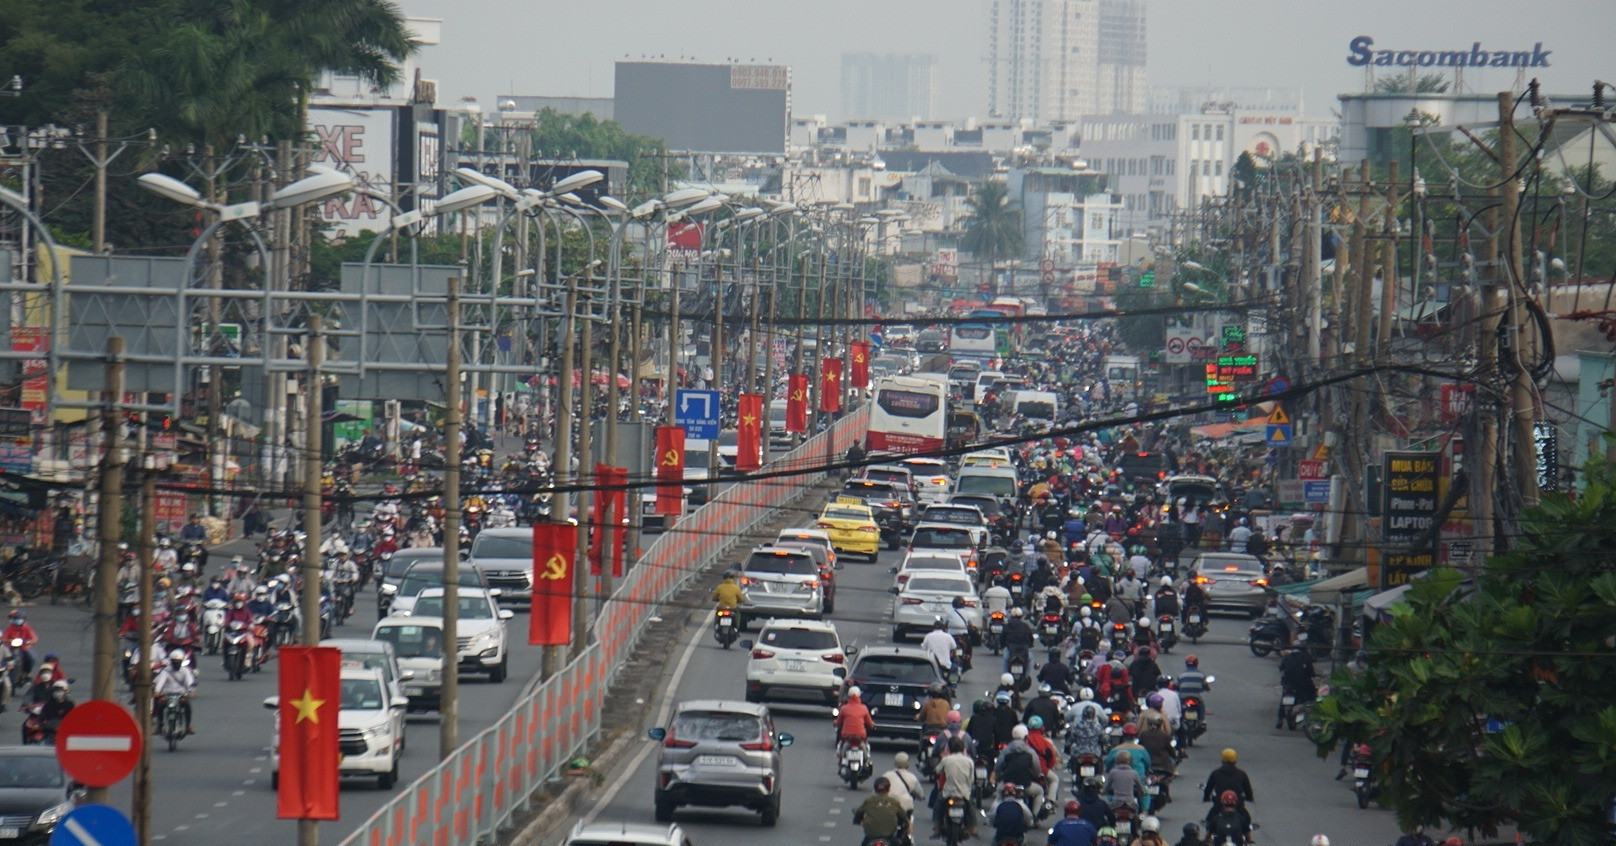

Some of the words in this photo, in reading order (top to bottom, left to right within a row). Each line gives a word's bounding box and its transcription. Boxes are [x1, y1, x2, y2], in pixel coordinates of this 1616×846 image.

[1346, 35, 1552, 67] Sacombank
[314, 124, 365, 163] XE
[1391, 460, 1413, 473] MUA
[1391, 517, 1433, 529] LAPTOP
